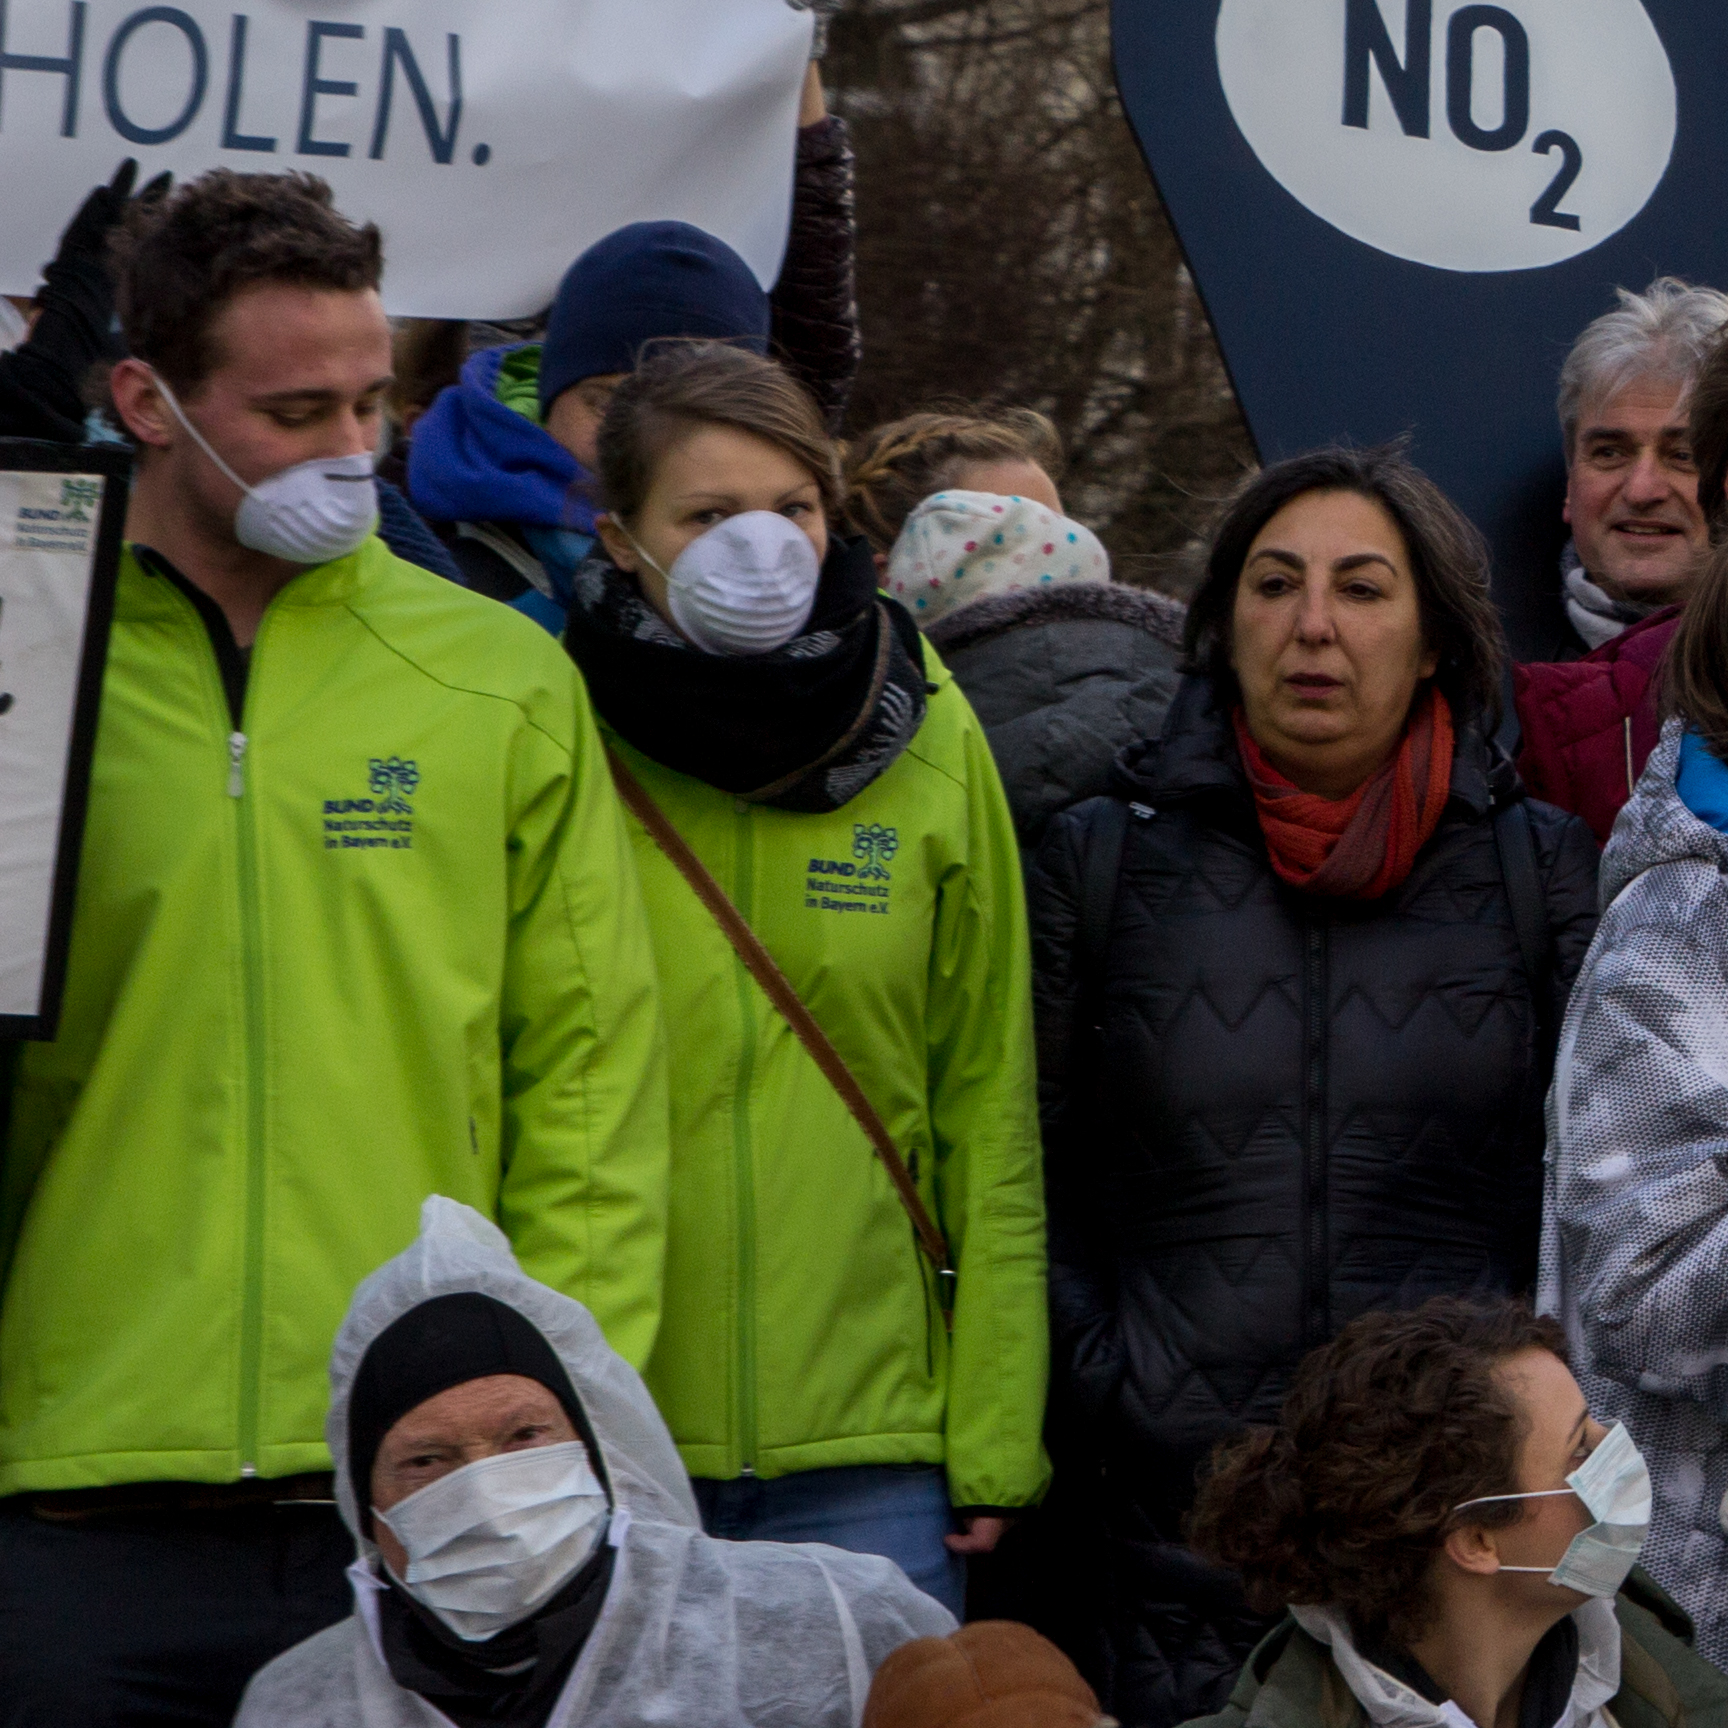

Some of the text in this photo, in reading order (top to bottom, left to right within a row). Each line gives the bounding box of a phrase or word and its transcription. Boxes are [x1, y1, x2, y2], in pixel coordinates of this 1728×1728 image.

[324, 799, 374, 814] BUND
[808, 858, 856, 876] BUND
[806, 877, 889, 897] Naturschutz
[804, 893, 818, 908] in
[821, 896, 867, 914] Bayern
